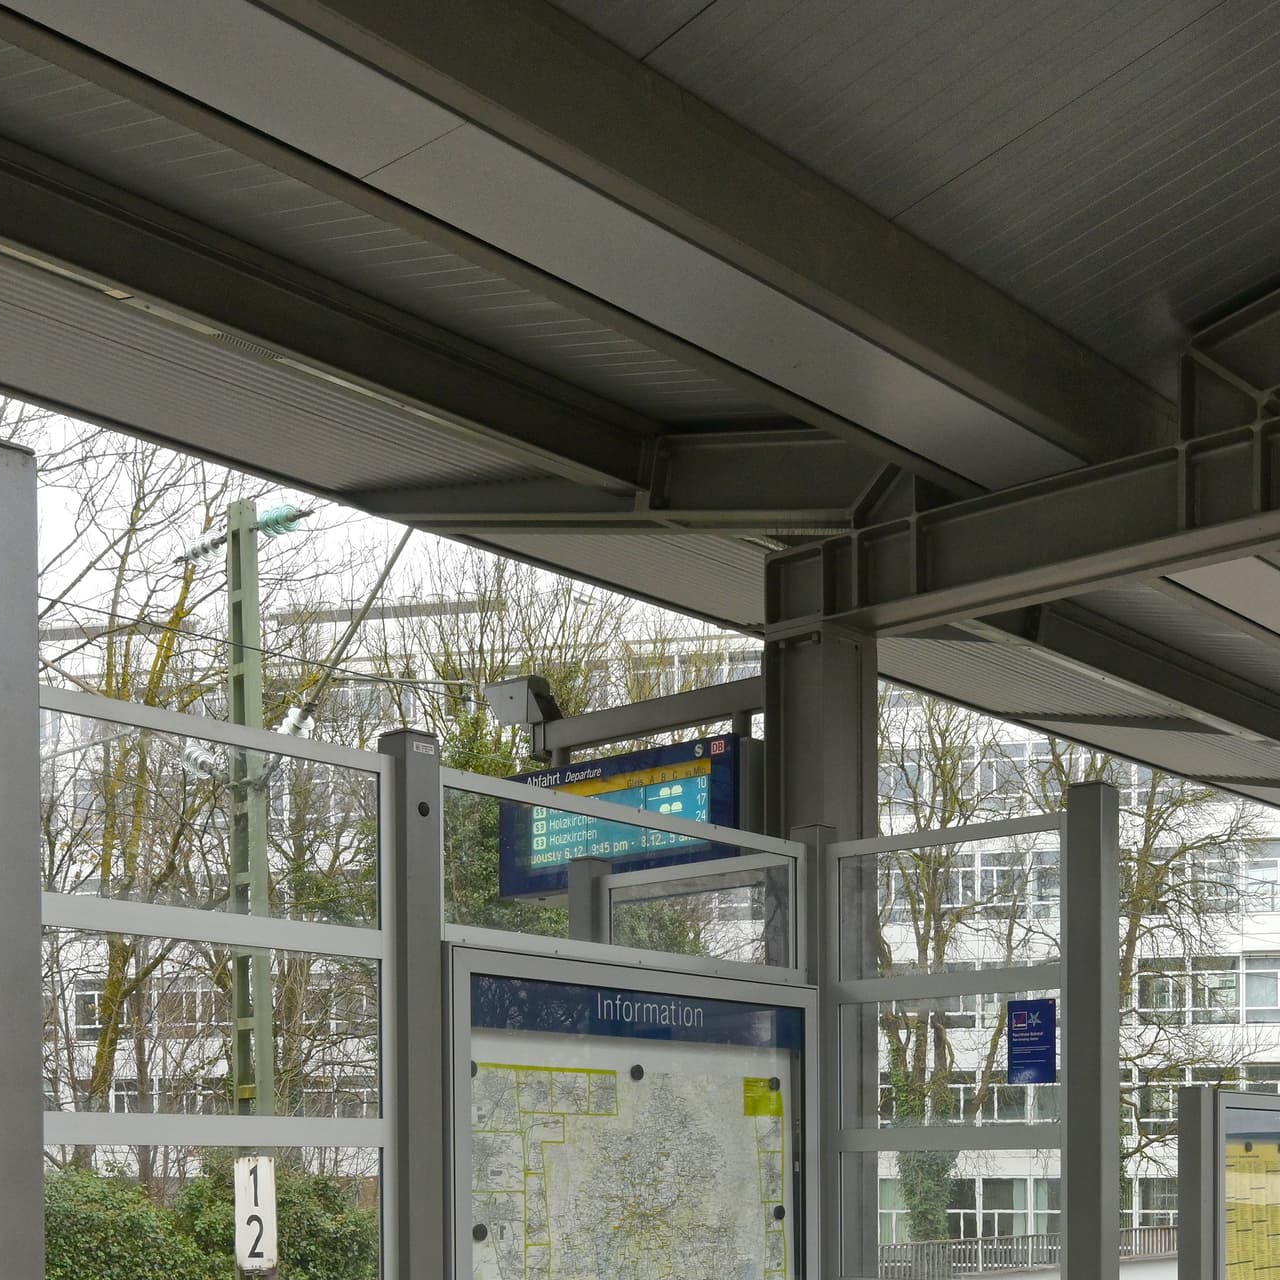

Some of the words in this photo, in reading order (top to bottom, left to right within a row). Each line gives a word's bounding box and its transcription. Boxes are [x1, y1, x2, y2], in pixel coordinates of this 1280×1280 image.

[712, 742, 724, 753] DB
[526, 772, 560, 789] Abfahrt
[565, 767, 602, 783] Departure
[696, 775, 707, 789] 10
[696, 792, 707, 805] 17
[695, 809, 706, 822] 24
[549, 829, 597, 846] Holzkirchen
[597, 992, 704, 1028] Information
[249, 1164, 259, 1207] 1
[246, 1214, 265, 1258] 2
